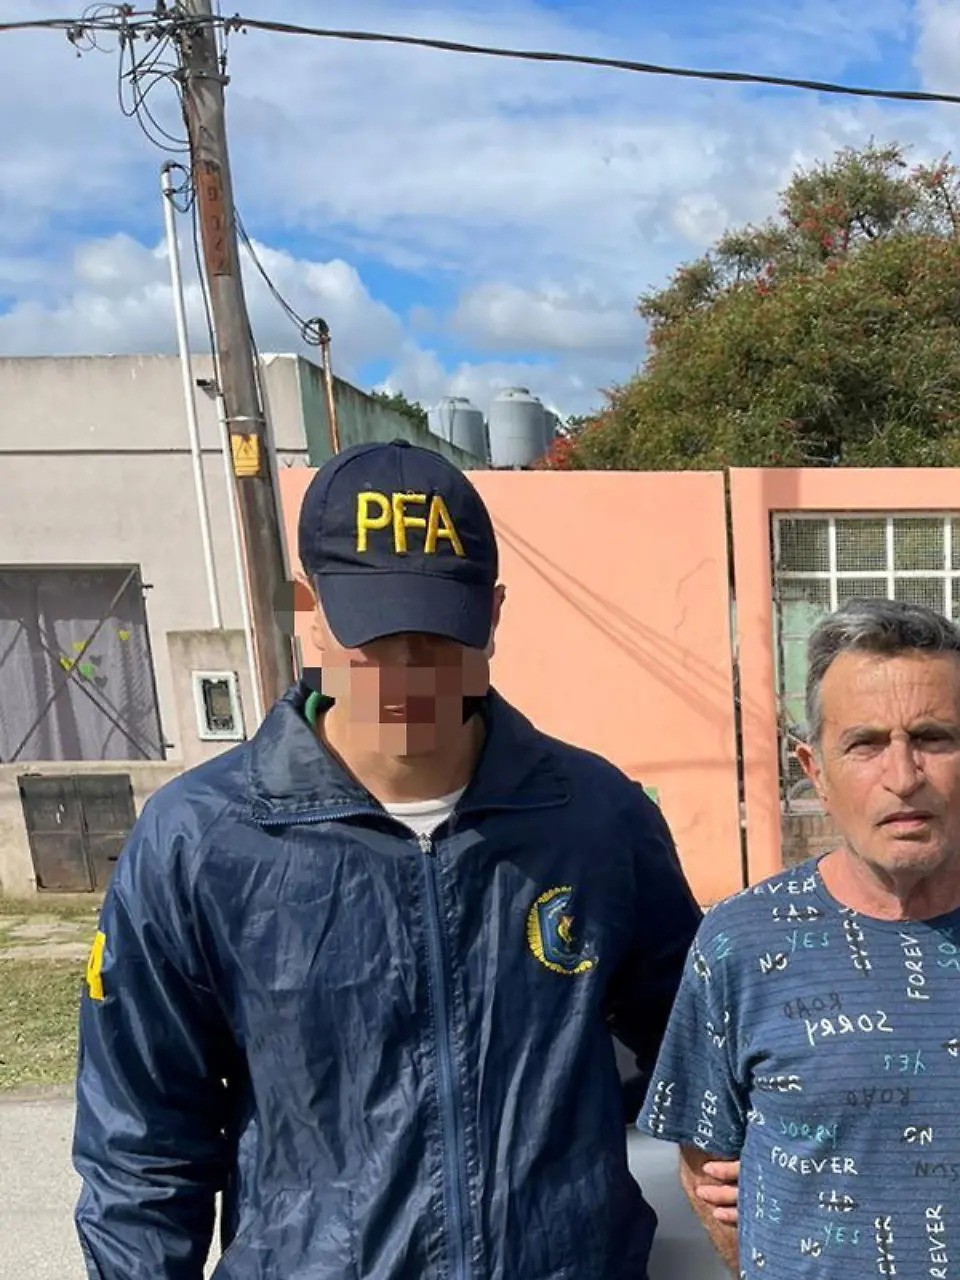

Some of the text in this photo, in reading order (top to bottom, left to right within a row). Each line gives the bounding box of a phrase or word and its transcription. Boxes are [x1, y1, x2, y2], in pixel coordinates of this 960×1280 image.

[356, 491, 466, 557] PFA
[785, 930, 830, 952] YES
[758, 951, 789, 974] NO
[780, 1118, 838, 1148] SORRY
[771, 1145, 859, 1176] FOREVER
[799, 1237, 823, 1259] NO
[821, 1220, 861, 1249] YES
